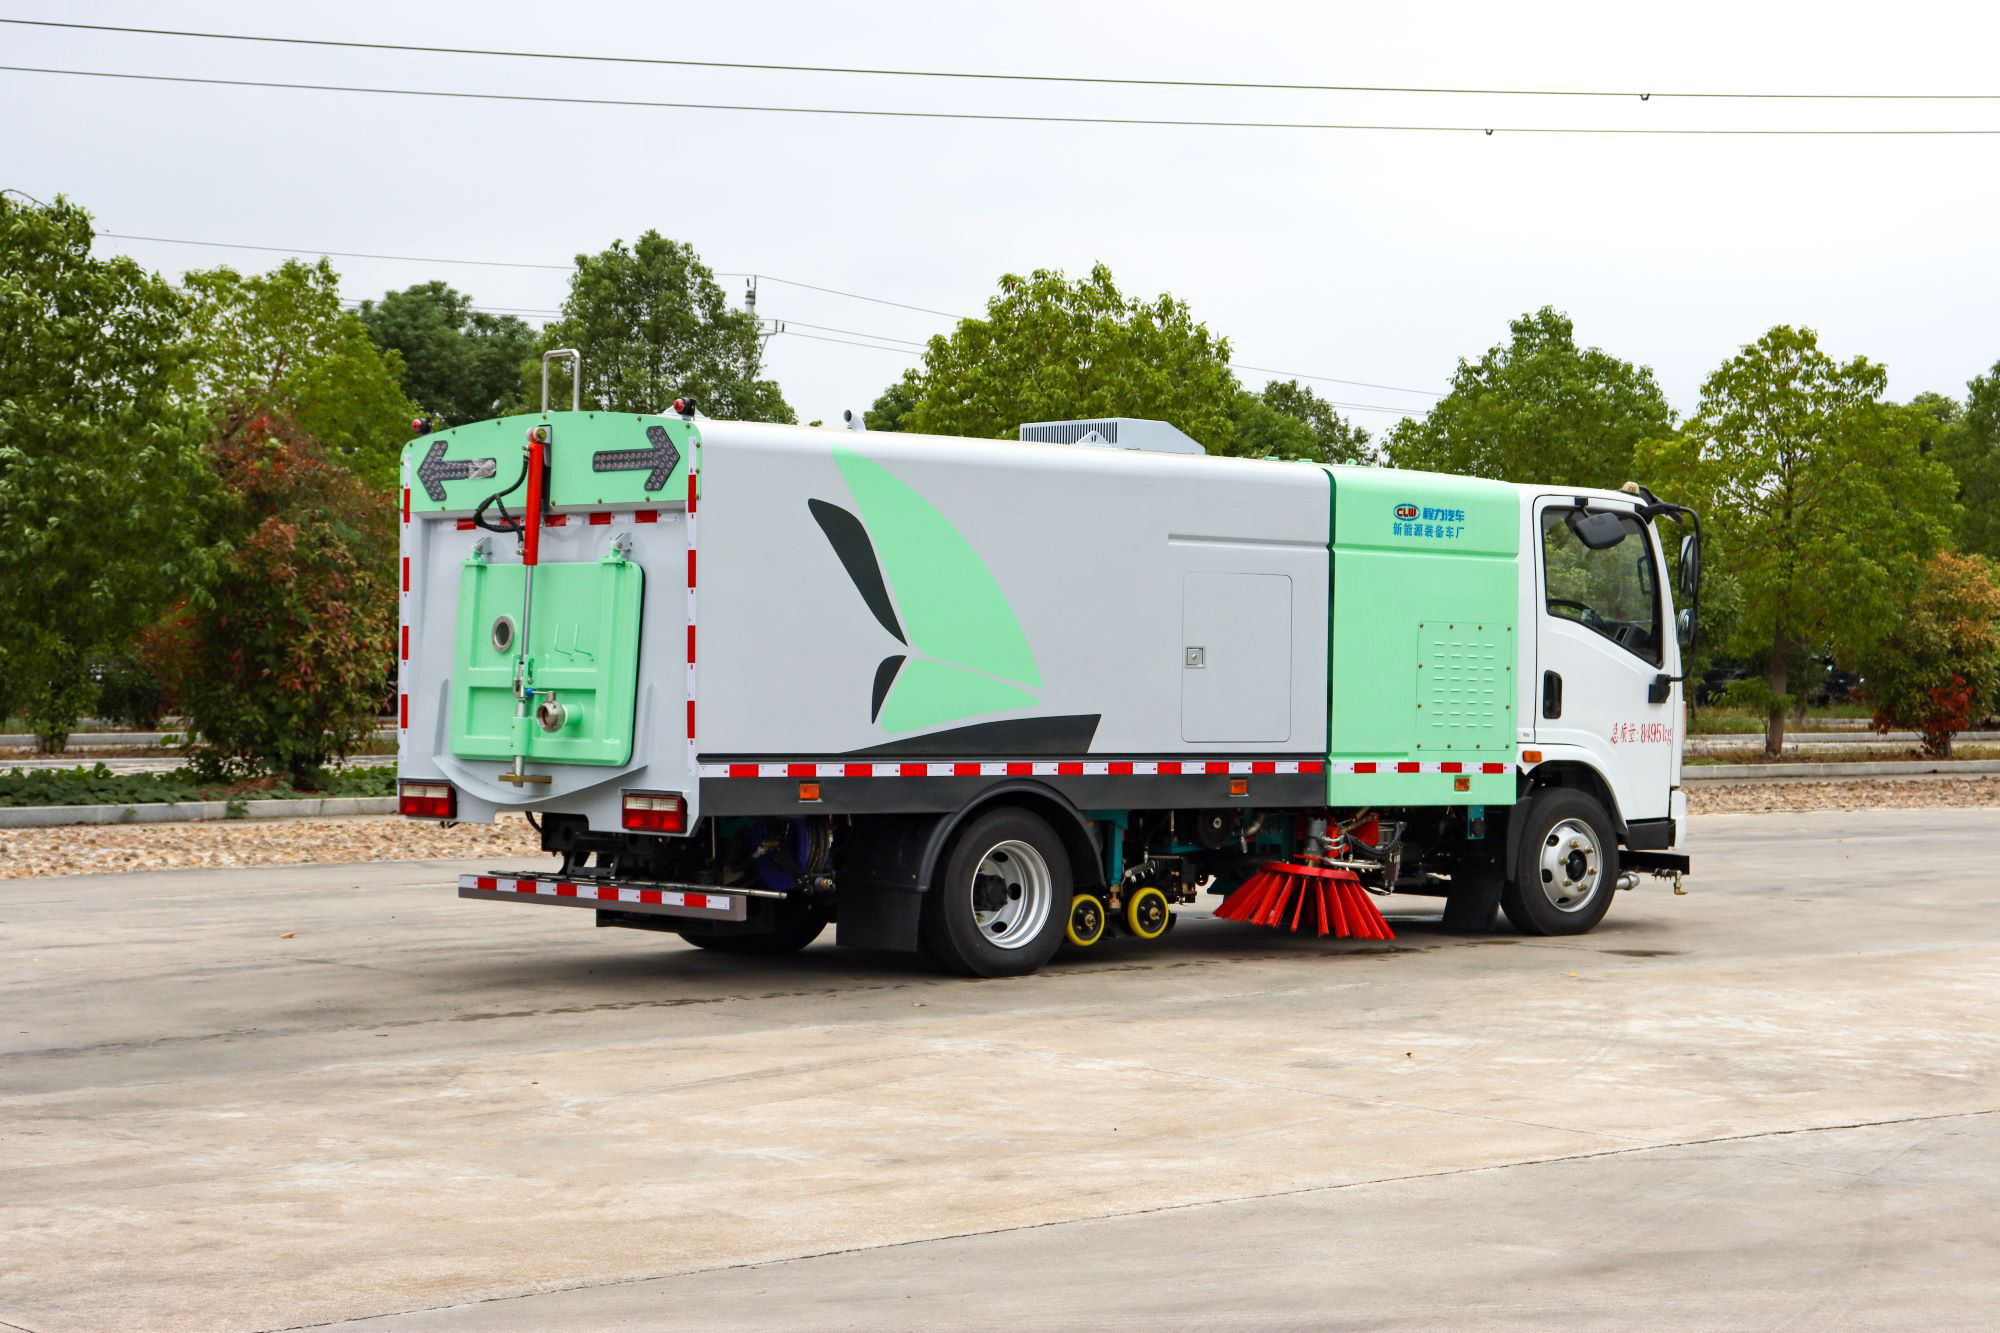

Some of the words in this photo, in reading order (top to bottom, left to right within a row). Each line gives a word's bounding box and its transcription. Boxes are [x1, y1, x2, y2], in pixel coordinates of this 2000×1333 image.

[1423, 507, 1465, 522] 程力汽车
[1393, 522, 1465, 539] 新能源装备车厂
